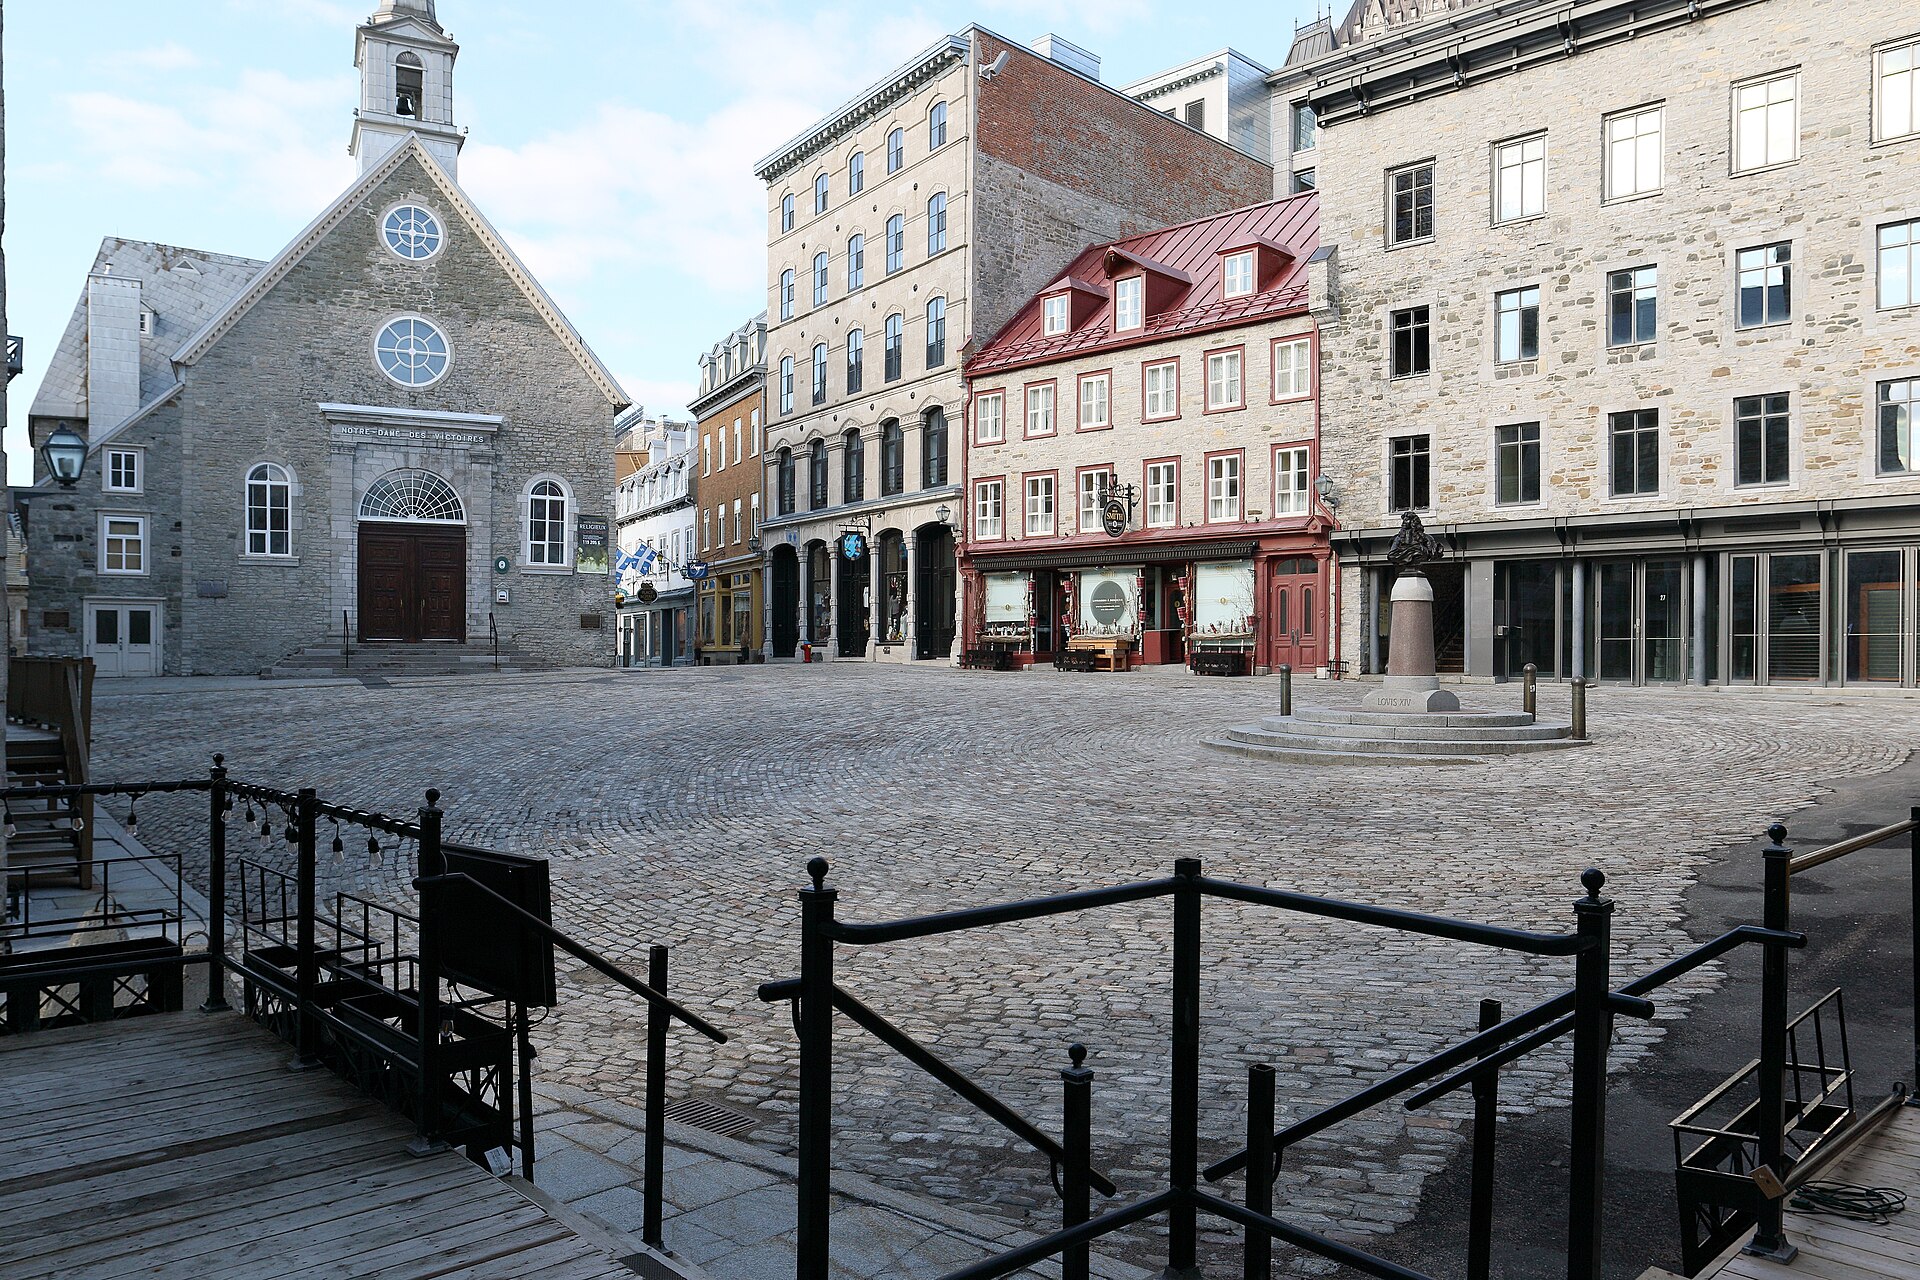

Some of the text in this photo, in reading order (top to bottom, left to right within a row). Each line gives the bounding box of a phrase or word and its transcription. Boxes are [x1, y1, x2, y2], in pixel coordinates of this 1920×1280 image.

[409, 431, 426, 439] DES
[434, 433, 484, 443] VICTOIRES
[1106, 512, 1125, 521] SMITH
[1399, 698, 1412, 706] XIV
